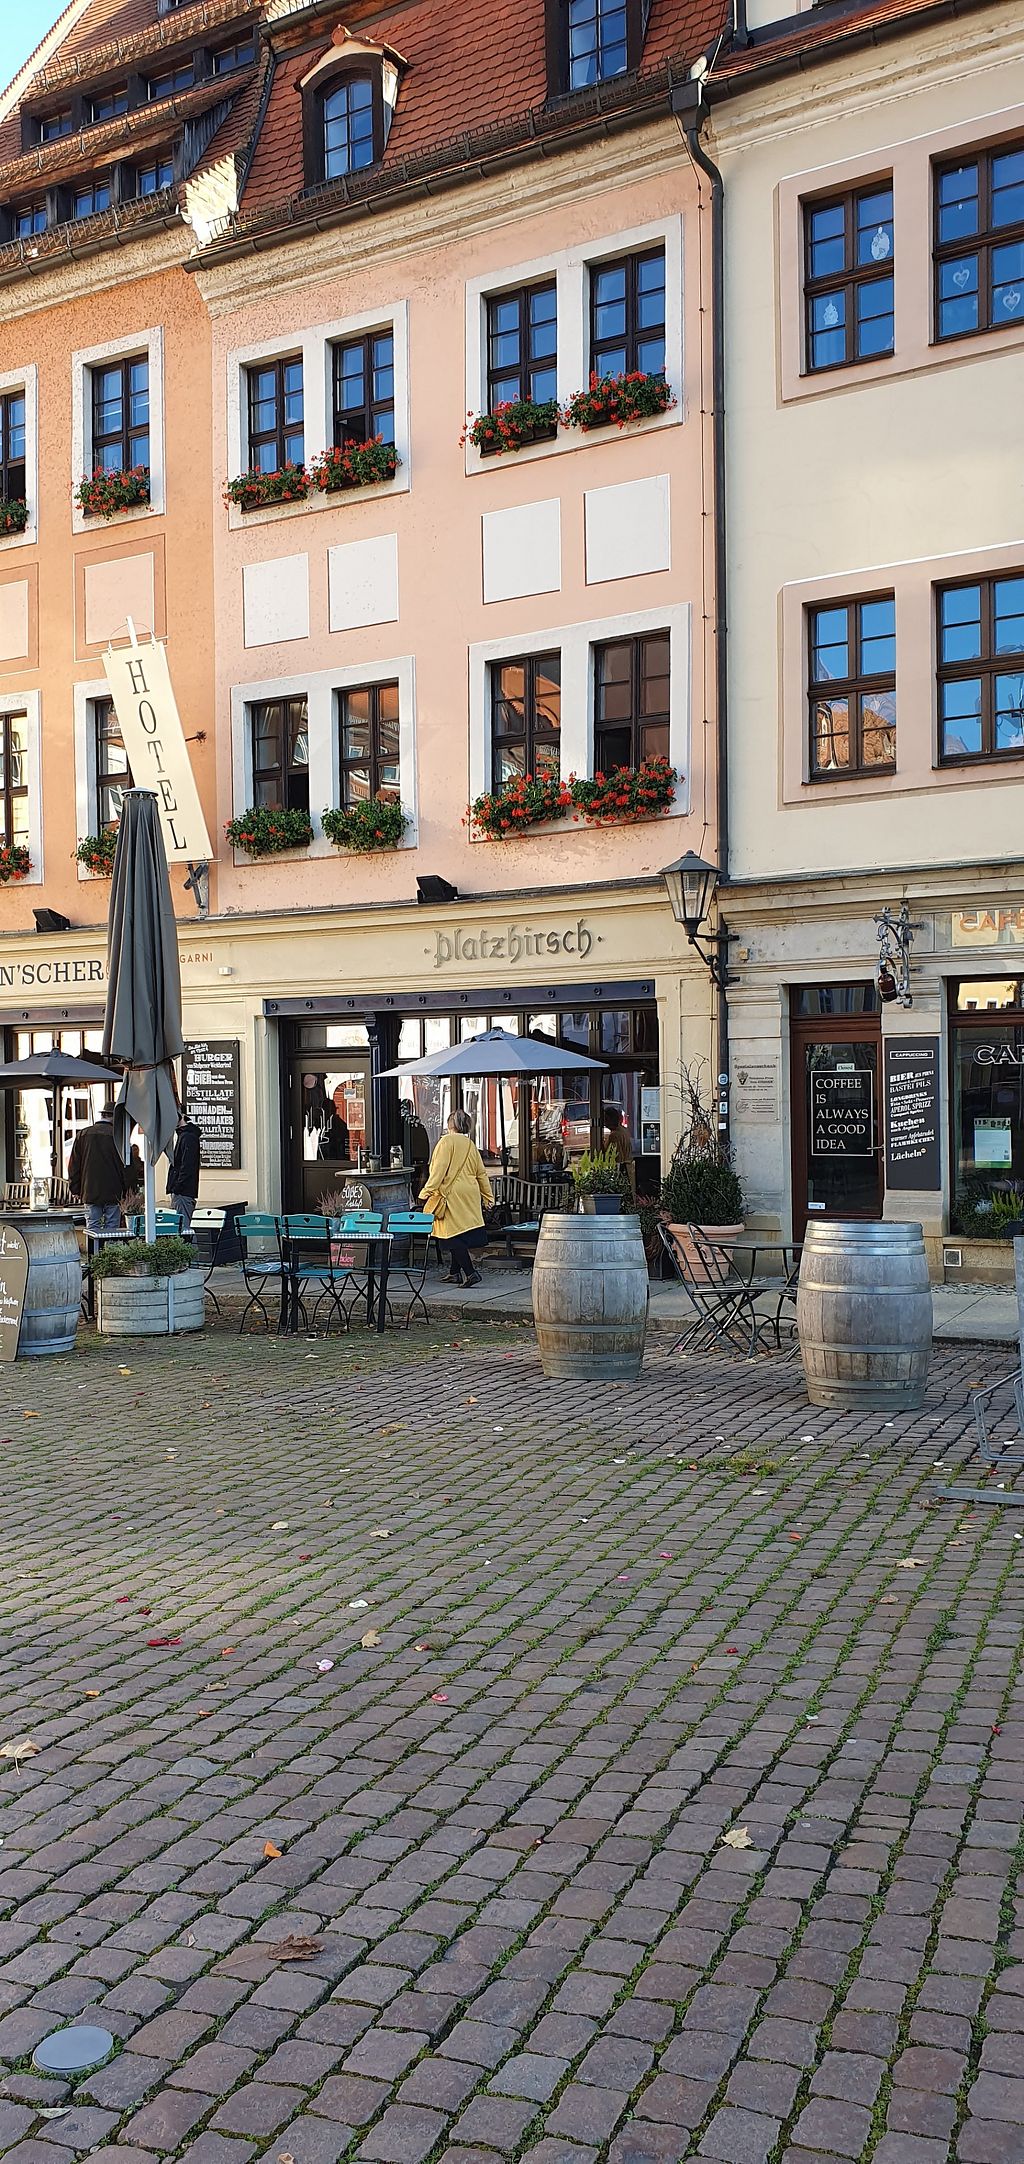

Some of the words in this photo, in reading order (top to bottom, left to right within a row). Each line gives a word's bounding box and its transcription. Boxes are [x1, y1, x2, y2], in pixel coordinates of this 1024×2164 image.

[125, 659, 187, 850] HOTEL
[433, 918, 592, 968] platzhirsch
[180, 952, 213, 964] GARNI
[194, 1054, 234, 1062] BURGER
[890, 1071, 914, 1083] BIER
[815, 1078, 862, 1089] COFFEE
[890, 1083, 914, 1093] BASTEI
[915, 1080, 931, 1089] PILS
[186, 1089, 234, 1098] DESTILLATE
[816, 1094, 827, 1104] IS
[816, 1108, 869, 1119] ALWAYS
[891, 1117, 925, 1129] Kuchen
[816, 1124, 825, 1134] A
[828, 1124, 866, 1134] GOOD
[816, 1139, 846, 1149] IDEA
[891, 1149, 922, 1161] Lächeln
